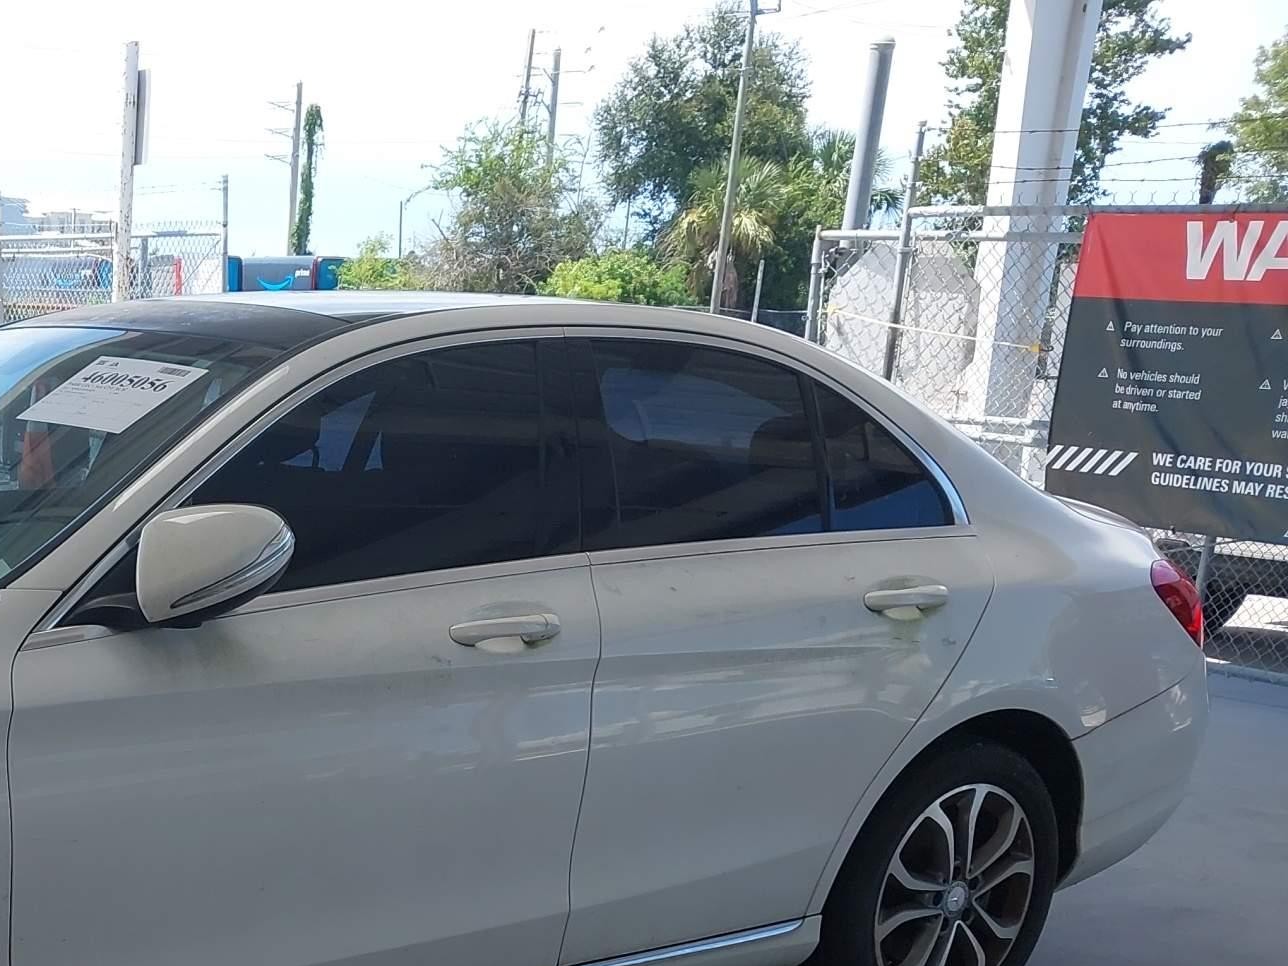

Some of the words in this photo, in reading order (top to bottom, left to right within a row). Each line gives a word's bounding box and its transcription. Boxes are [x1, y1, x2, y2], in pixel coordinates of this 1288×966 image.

[1124, 321, 1143, 335] Pay
[1144, 323, 1187, 335] attention
[1189, 326, 1199, 336] to
[1201, 328, 1224, 338] your
[1120, 338, 1185, 352] surroundings.
[81, 371, 175, 393] 46005056
[1117, 368, 1128, 379] No
[1130, 370, 1167, 382] vehicles
[1169, 373, 1200, 385] should
[1115, 383, 1125, 394] be
[1126, 384, 1154, 397] driven
[1156, 388, 1166, 398] or
[1168, 389, 1202, 400] started
[1112, 400, 1122, 409] at
[1123, 401, 1159, 413] anytime.
[1152, 452, 1174, 467] WE
[1176, 455, 1213, 471] CARE
[1215, 458, 1242, 474] FOR
[1245, 461, 1283, 478] YOUR
[1151, 471, 1230, 493] GUIDELINES
[1232, 480, 1264, 496] MAY
